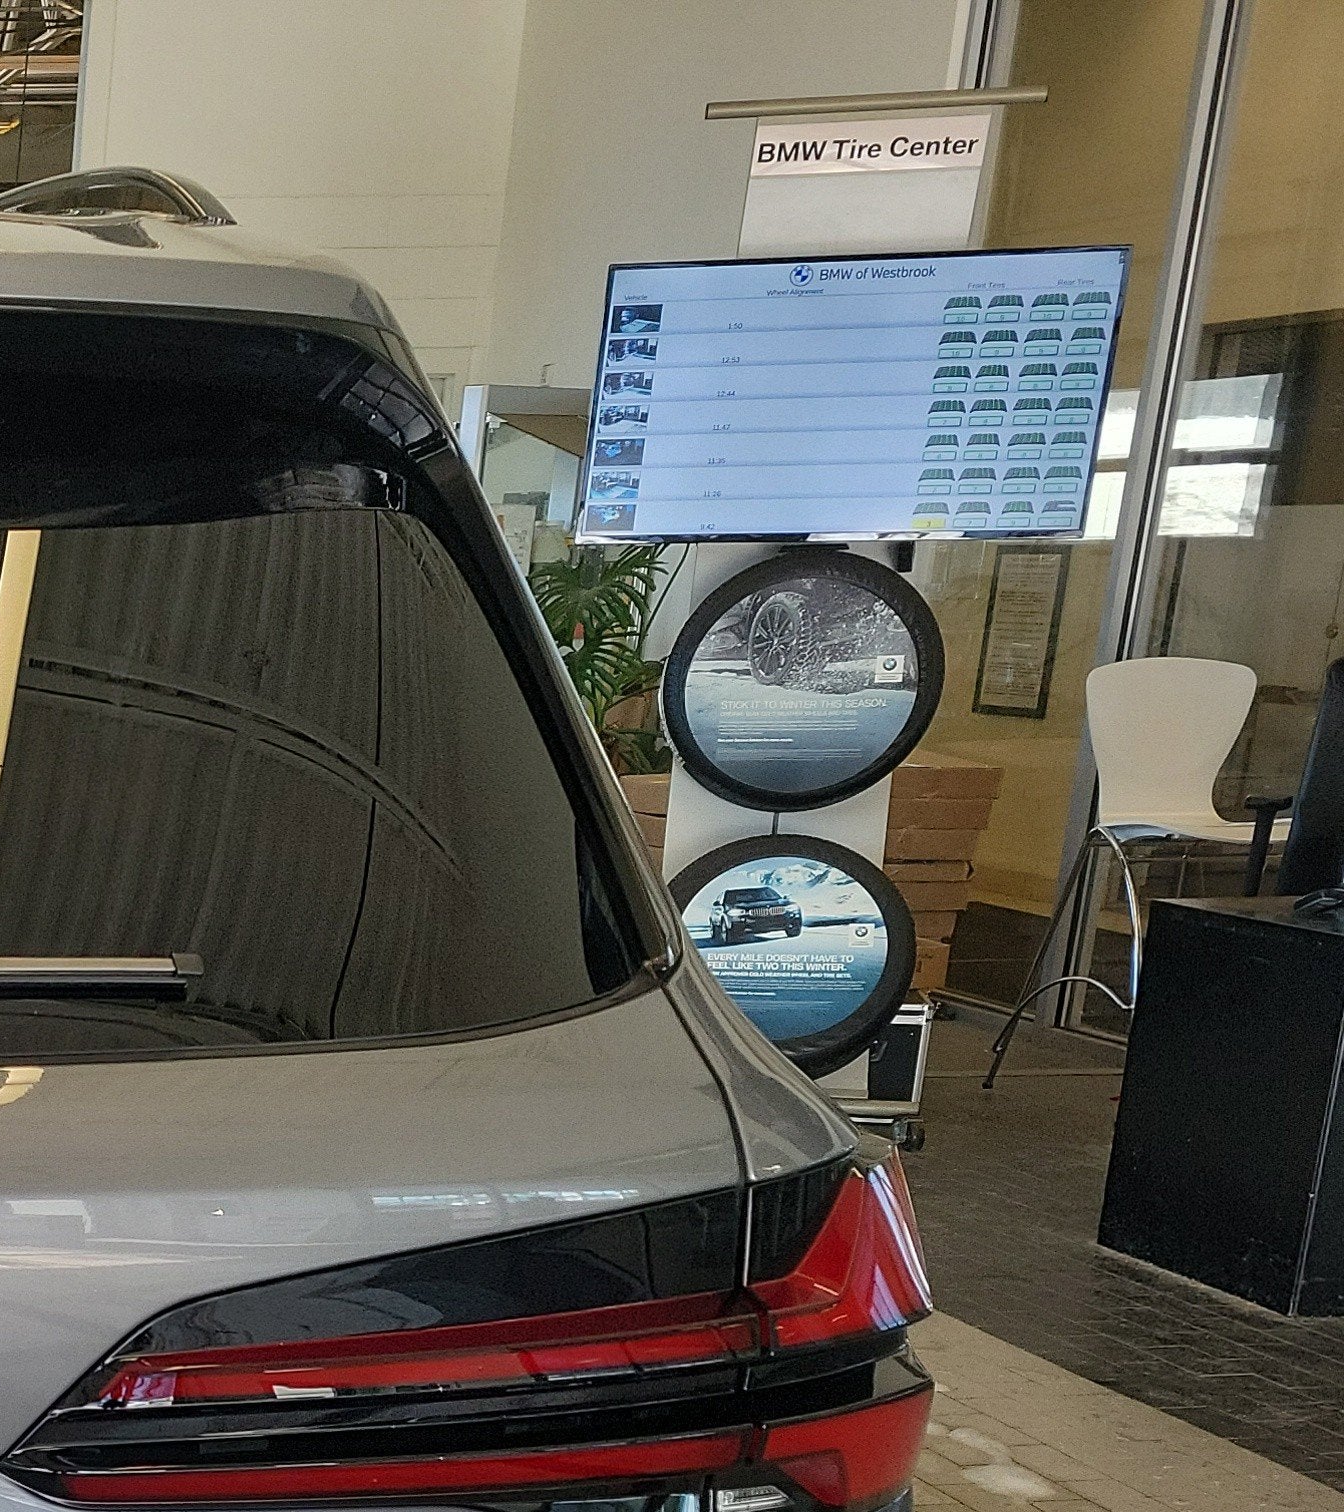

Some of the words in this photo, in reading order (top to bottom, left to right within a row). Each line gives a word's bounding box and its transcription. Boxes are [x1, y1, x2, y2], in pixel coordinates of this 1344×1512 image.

[757, 140, 828, 163] BMW
[833, 138, 882, 160] Tire
[890, 136, 980, 158] Center
[819, 268, 853, 281] BMW
[855, 268, 868, 280] of
[871, 265, 937, 280] Westbrook
[766, 288, 789, 297] Wheel
[789, 287, 825, 297] Alignment
[764, 701, 778, 709] TO
[780, 699, 817, 709] WINTER
[821, 699, 843, 709] THIS
[707, 952, 739, 961] EVERY
[740, 953, 764, 962] MILE
[765, 953, 810, 962] DOESN'T
[810, 954, 838, 963] HAVE
[841, 954, 854, 963] TO
[707, 961, 731, 970] FEEL
[732, 961, 754, 970] LIKE
[755, 962, 779, 971] TWO
[781, 962, 804, 971] THIS
[805, 962, 848, 972] WINTER.
